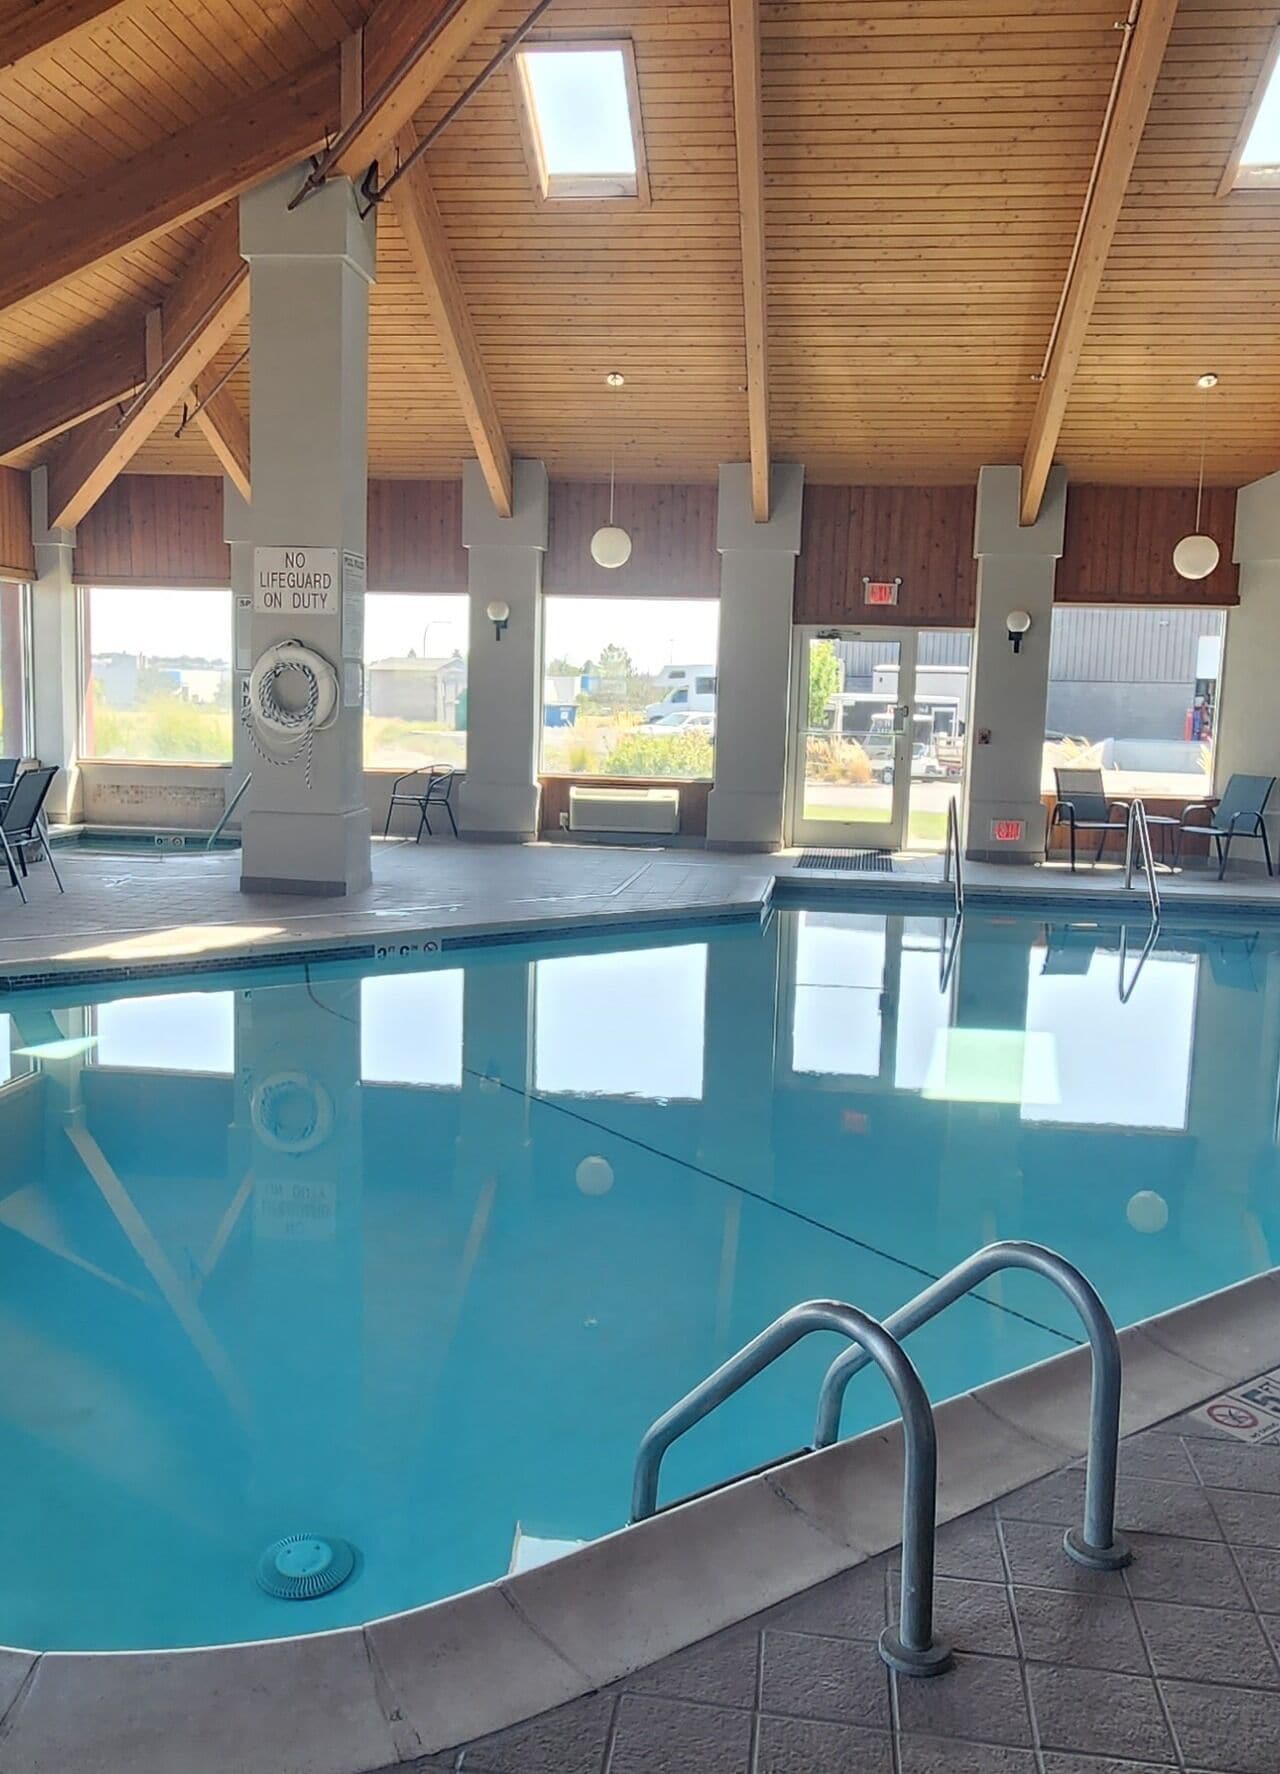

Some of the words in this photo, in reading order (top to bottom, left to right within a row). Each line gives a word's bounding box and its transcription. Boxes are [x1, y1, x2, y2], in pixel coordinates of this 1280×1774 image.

[284, 552, 306, 568] NO
[260, 572, 331, 589] LIFEGUARD
[263, 592, 282, 608] ON
[292, 593, 328, 609] DUTY
